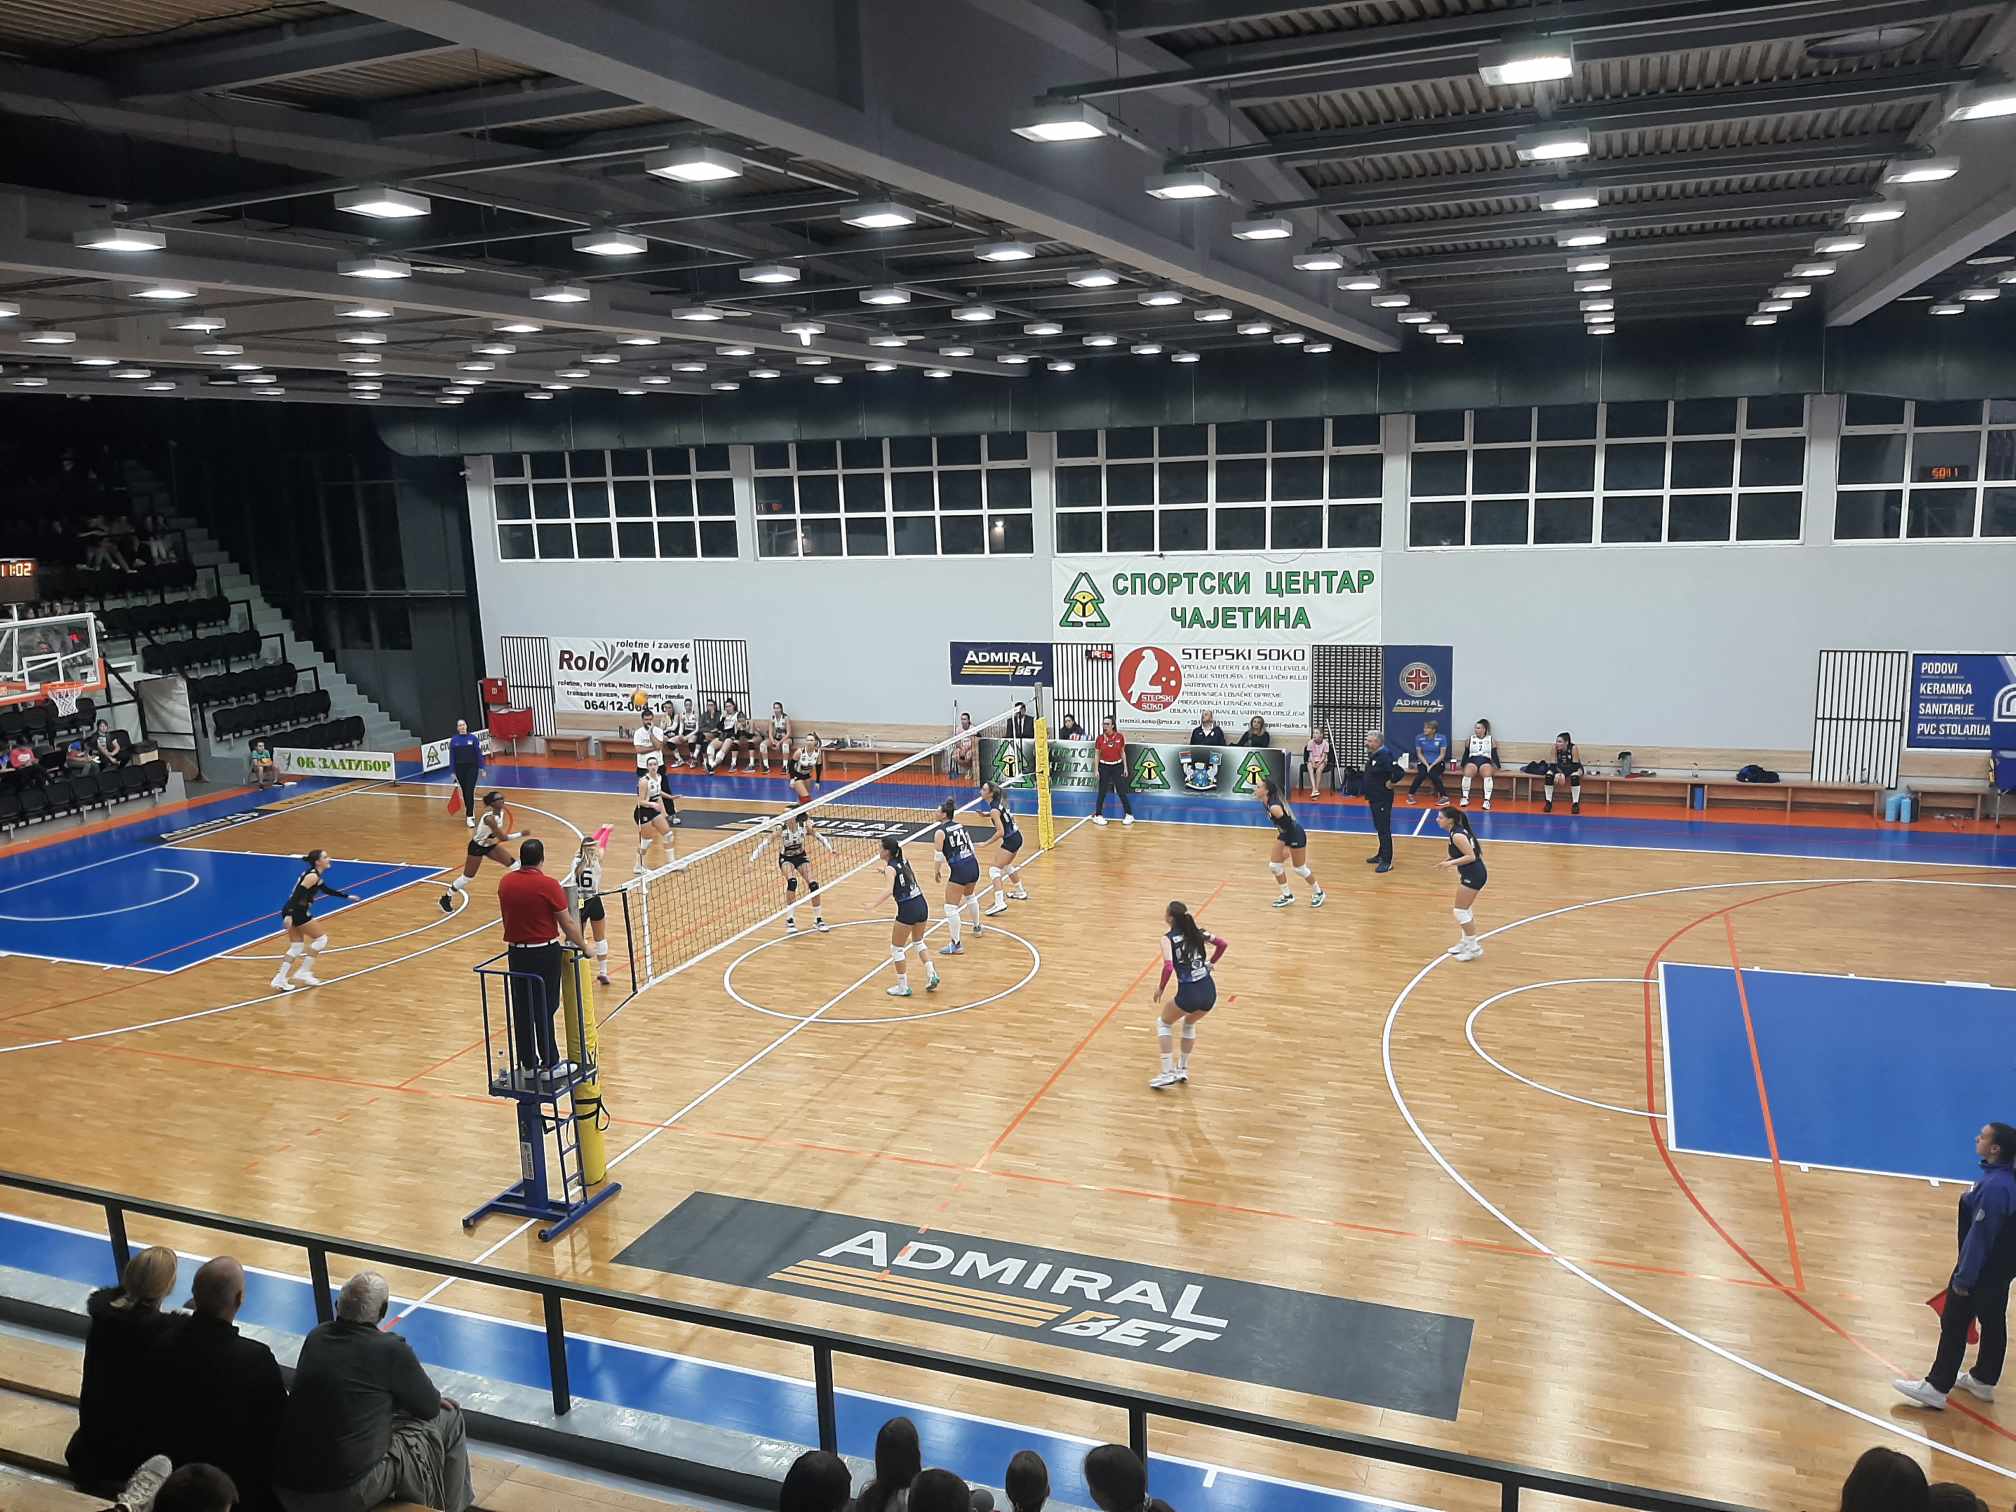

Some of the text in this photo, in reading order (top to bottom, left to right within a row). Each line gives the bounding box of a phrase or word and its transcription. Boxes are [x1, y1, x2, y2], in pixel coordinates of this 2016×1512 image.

[1113, 570, 1375, 597] СПОРТСКИ ЦЕНТАР
[1171, 607, 1311, 629] ЧАЈЕТИНА
[658, 641, 690, 649] zavese
[965, 651, 1043, 664] ADMIRAL
[1182, 648, 1305, 661] STEPSKI SOKO
[559, 650, 690, 673] Rolo Mont
[1921, 662, 1958, 674] PODOVI
[1014, 666, 1042, 675] BET
[1920, 683, 1973, 695] KERAMIKA
[1395, 699, 1444, 707] ADMIRAL
[1919, 703, 1975, 715] SANITARIJE
[1917, 723, 1937, 735] PVC
[296, 757, 391, 772] ОК ЗЛАТИБОР
[817, 1230, 1229, 1329] ADMIRAL
[1050, 1310, 1222, 1353] BET
